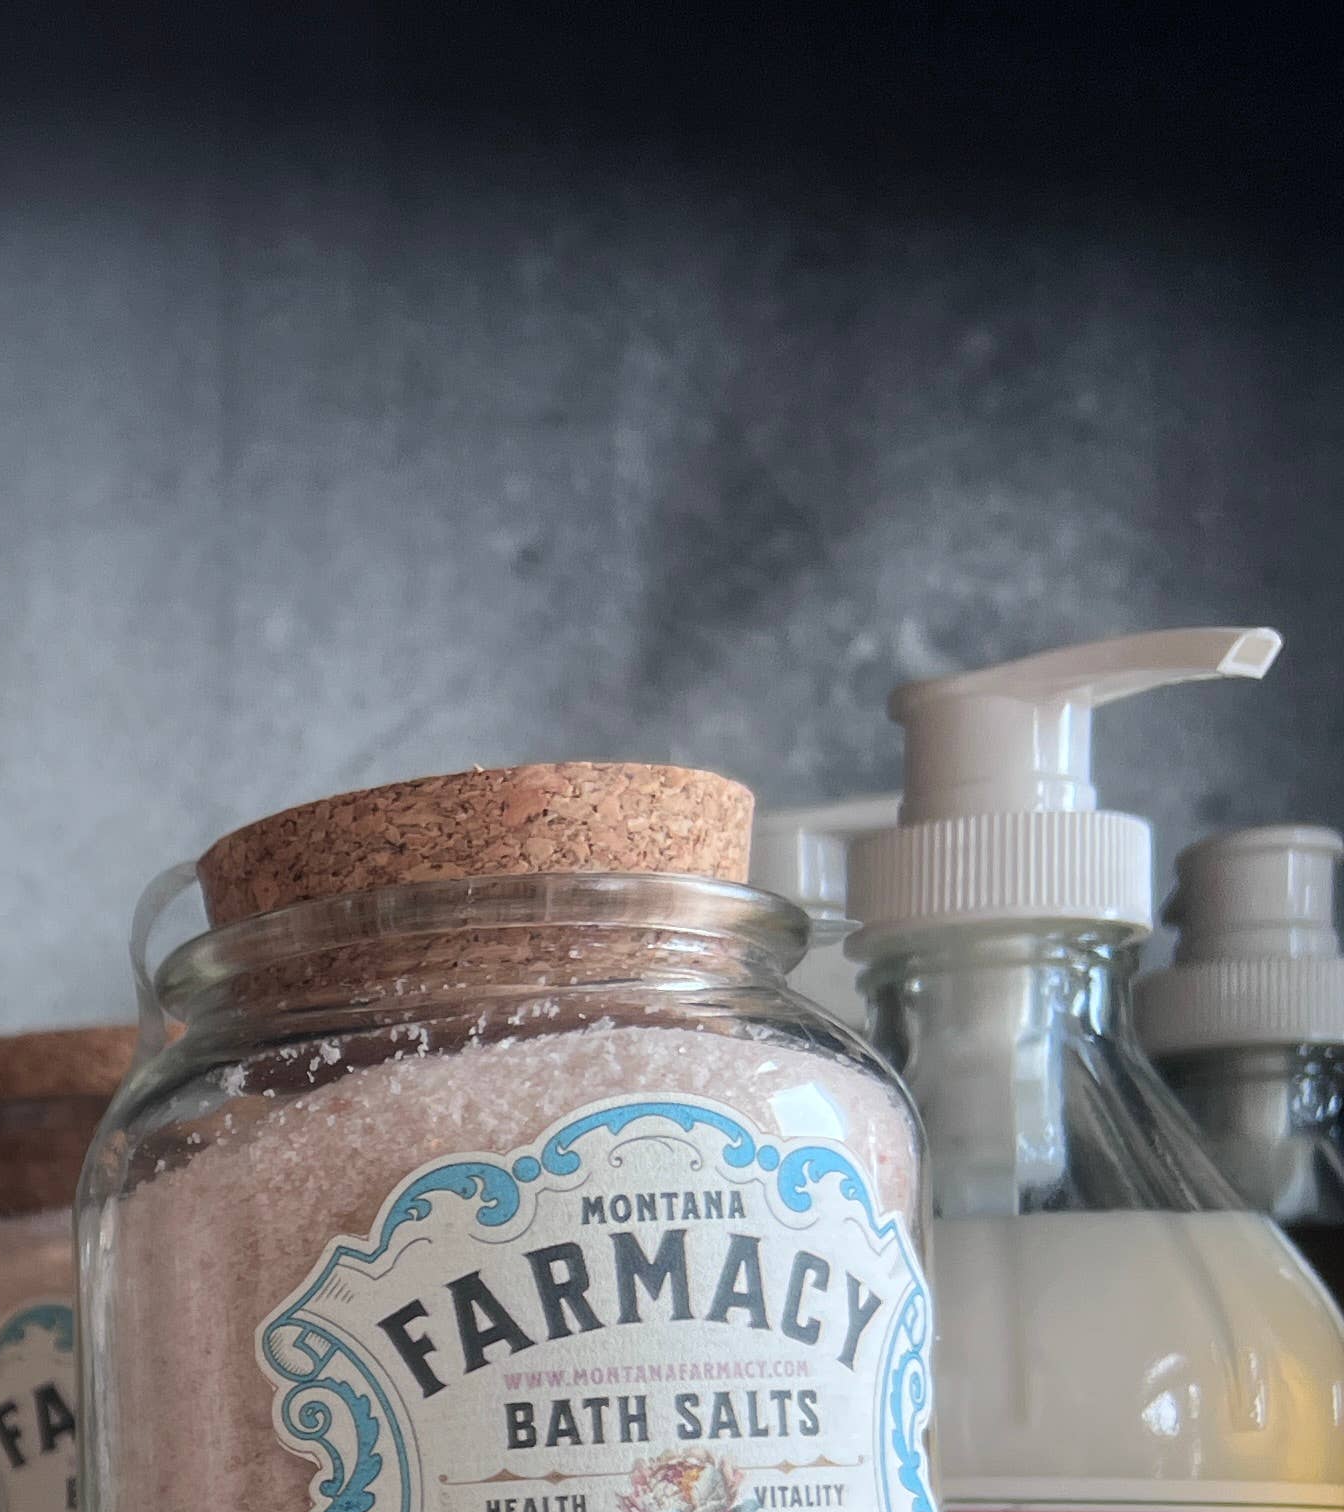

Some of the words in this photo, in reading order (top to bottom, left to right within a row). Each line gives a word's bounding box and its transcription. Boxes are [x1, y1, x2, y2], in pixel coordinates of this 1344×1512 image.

[581, 1191, 747, 1226] MONTANA
[377, 1229, 884, 1399] FARMACY
[503, 1360, 810, 1391] WWW.MONTANAFARMACY.COM
[505, 1392, 651, 1451] BATH
[676, 1389, 820, 1440] SALTS
[753, 1484, 844, 1509] VITALITY
